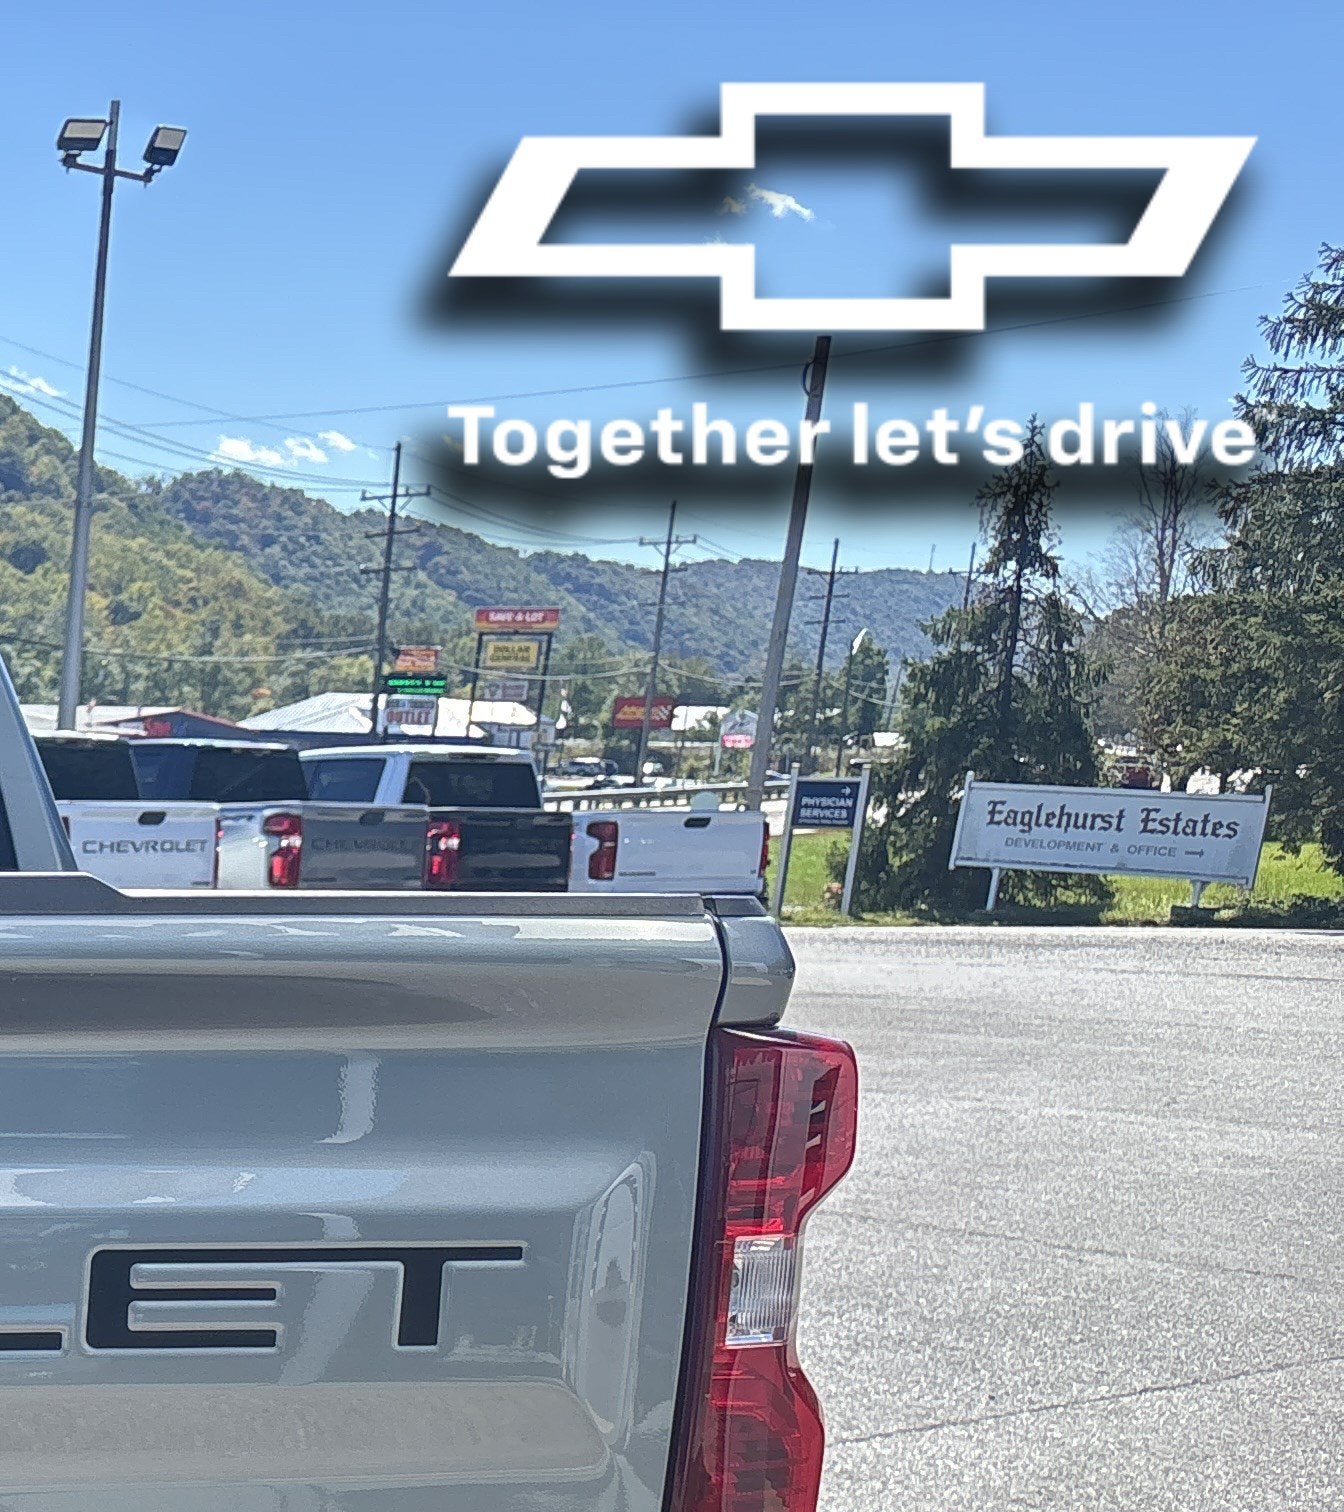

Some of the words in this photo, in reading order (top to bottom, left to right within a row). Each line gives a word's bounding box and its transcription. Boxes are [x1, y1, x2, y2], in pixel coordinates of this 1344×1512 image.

[801, 796, 853, 807] PHYSICIAN
[800, 807, 848, 818] SERVICES
[986, 800, 1126, 833] Eaglehurst
[1139, 807, 1241, 840] Estates
[82, 839, 208, 854] CHEVROLET
[1004, 837, 1104, 853] DEVELOPMENT
[1110, 843, 1119, 854] &
[1126, 843, 1178, 858] OFFICE
